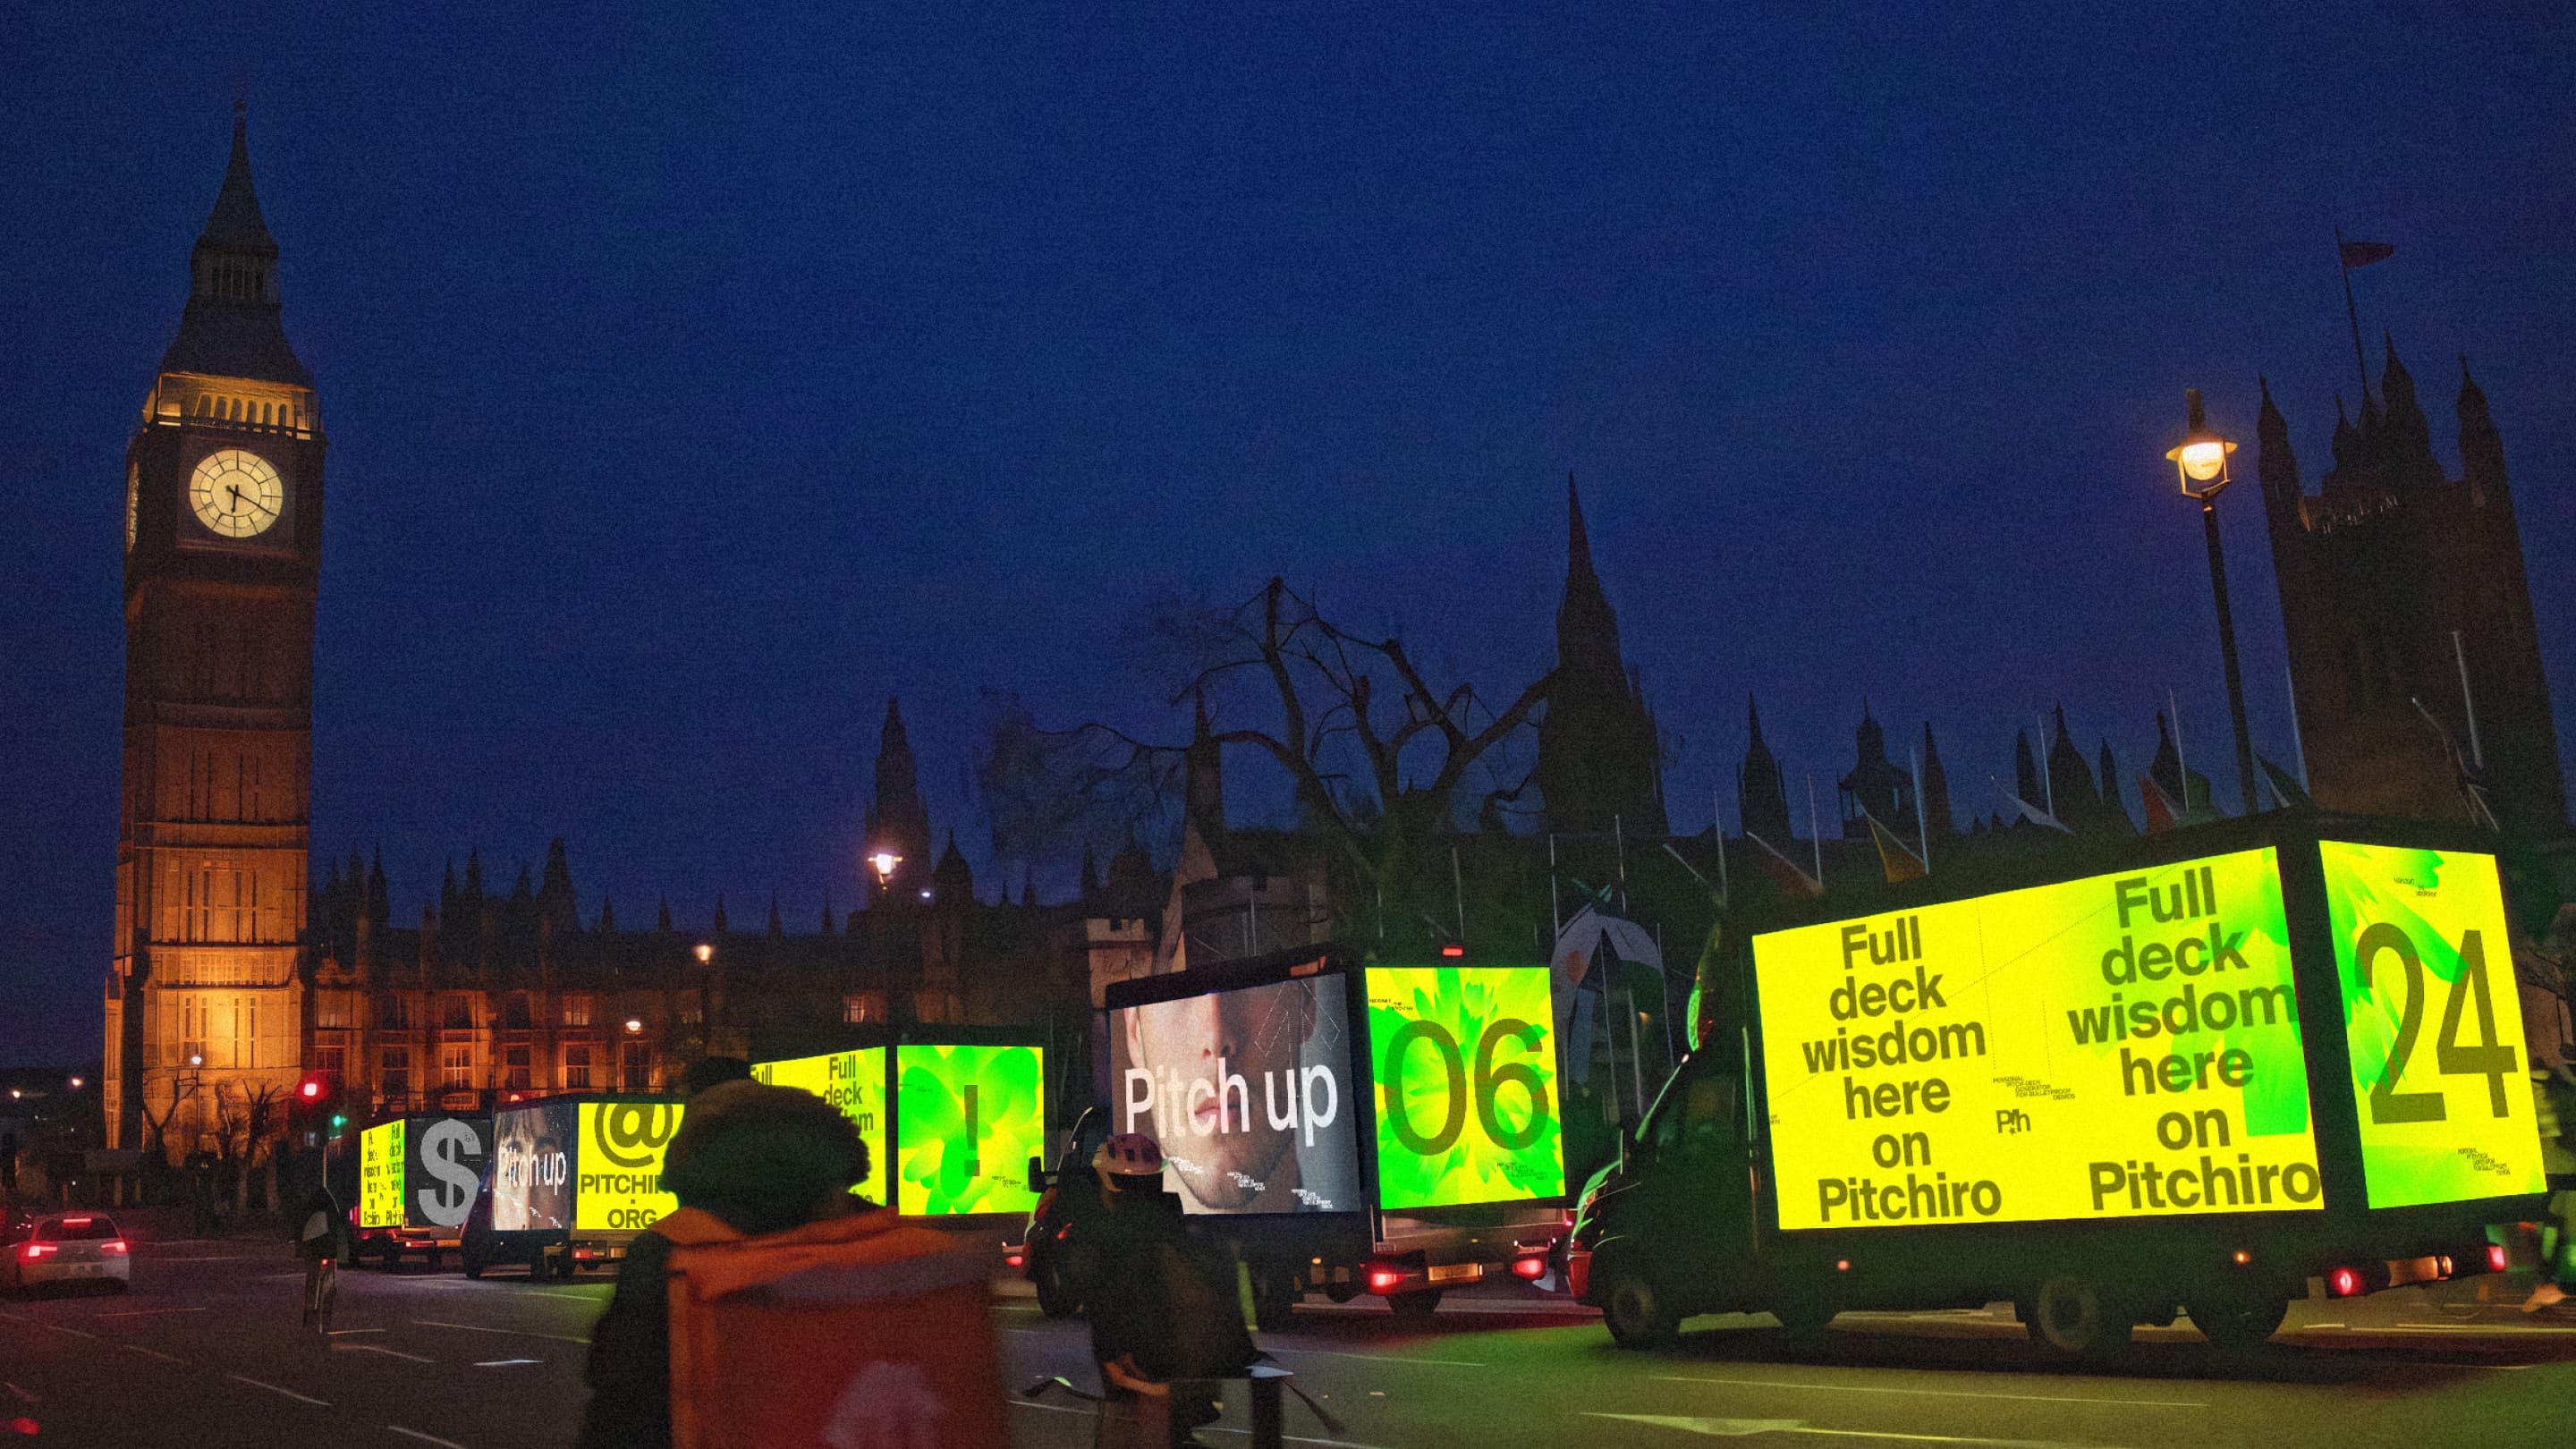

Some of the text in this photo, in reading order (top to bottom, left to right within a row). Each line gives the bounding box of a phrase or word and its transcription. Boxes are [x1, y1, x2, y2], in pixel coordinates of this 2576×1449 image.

[2114, 866, 2217, 928] Full
[1841, 916, 1921, 970] Full
[2101, 925, 2250, 986] deck
[1829, 967, 1947, 1021] deck
[2067, 983, 2299, 1045] wisdom
[1802, 1019, 1986, 1073] wisdom
[2355, 922, 2518, 1124] 24
[823, 1080, 863, 1106] deck
[829, 1054, 856, 1080] Full
[1384, 1017, 1549, 1156] 06
[2119, 1046, 2255, 1096] here
[1124, 1057, 1338, 1148] Pitch up
[1844, 1076, 1951, 1120] here
[594, 1104, 673, 1167] @
[1872, 1131, 1931, 1168] on
[2157, 1109, 2231, 1151] on
[418, 1118, 482, 1225] $
[543, 1151, 567, 1196] up
[1818, 1171, 2003, 1222] Pitchiro
[2089, 1154, 2322, 1211] Pitchiro
[607, 1208, 657, 1229] ORG
